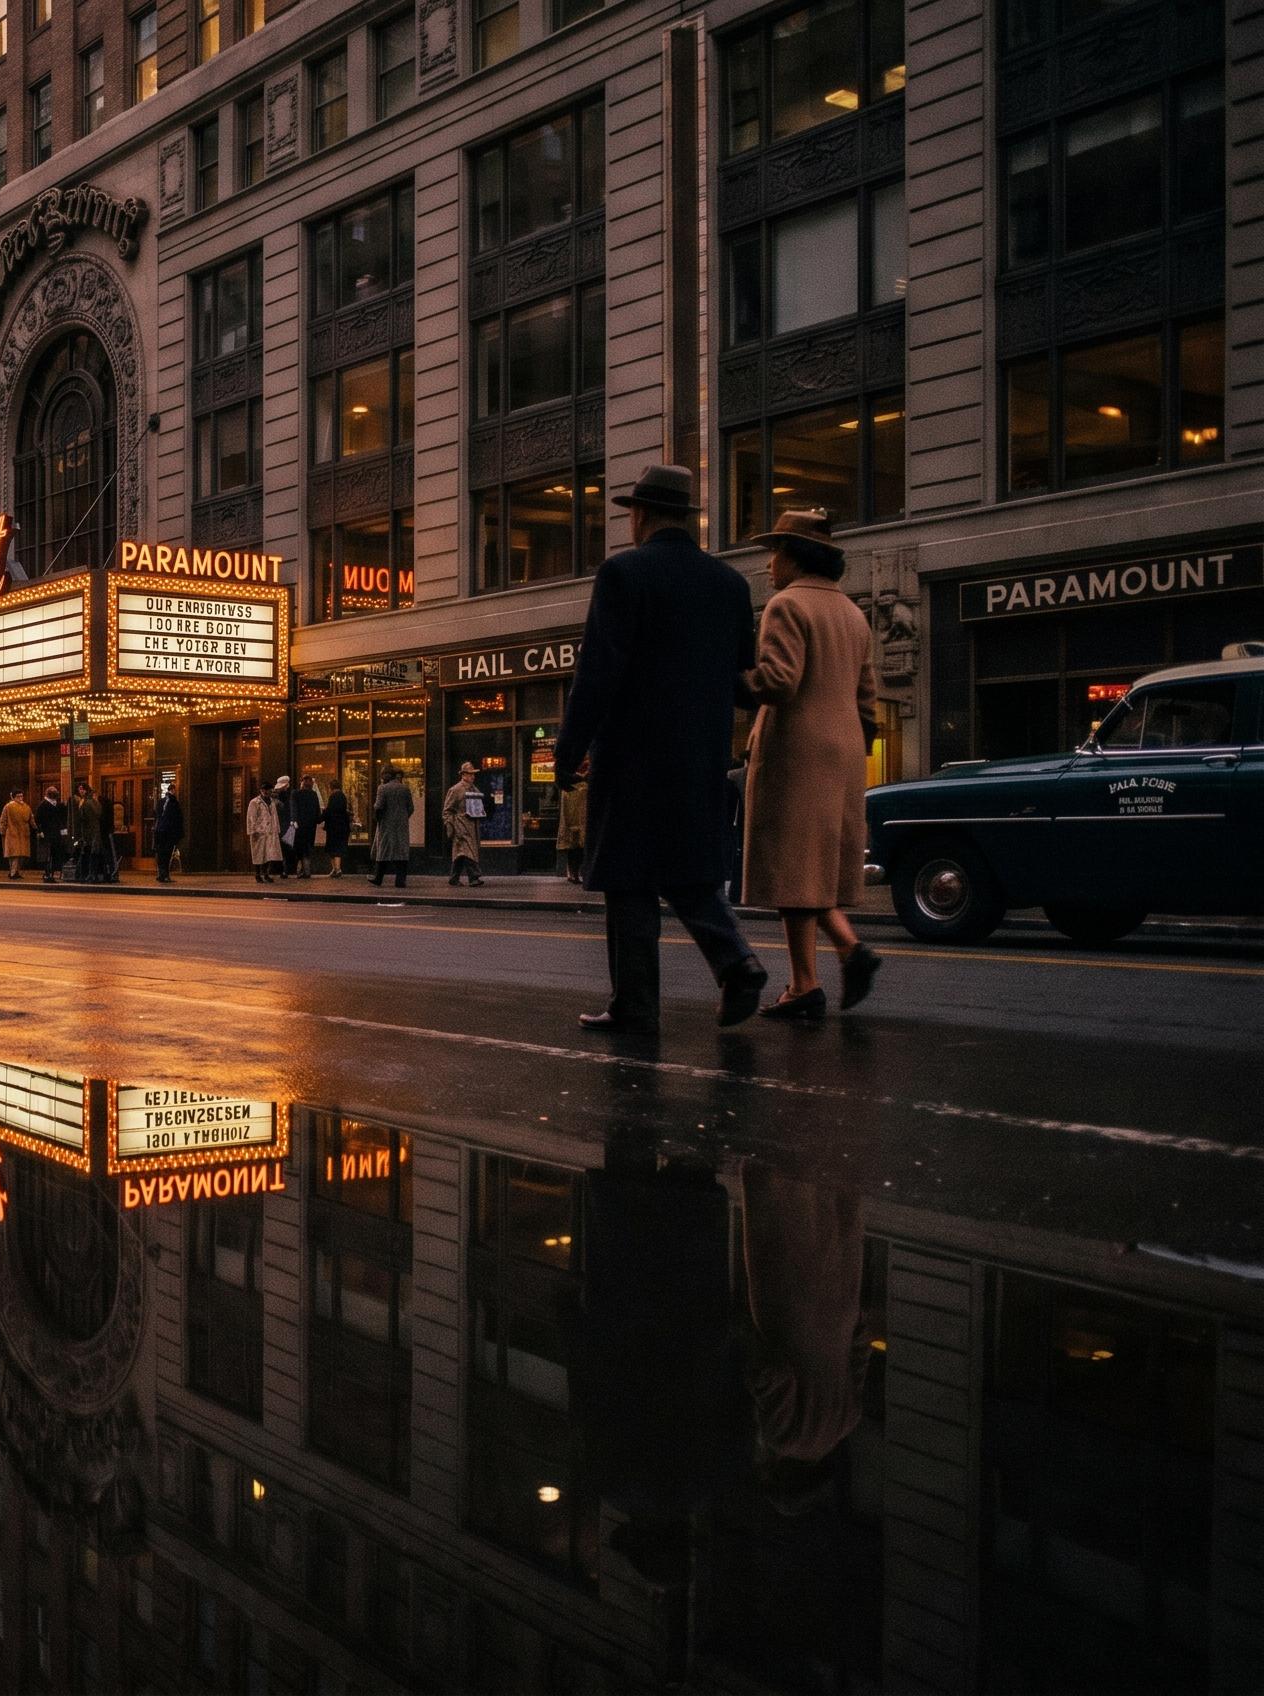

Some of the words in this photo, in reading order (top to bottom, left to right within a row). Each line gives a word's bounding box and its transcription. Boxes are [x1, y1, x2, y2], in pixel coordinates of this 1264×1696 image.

[120, 542, 283, 583] PARAMOUNT
[987, 554, 1233, 613] PARAMOUNT
[146, 597, 173, 612] OUR
[458, 653, 513, 680] HAIL
[524, 643, 583, 672] CAB
